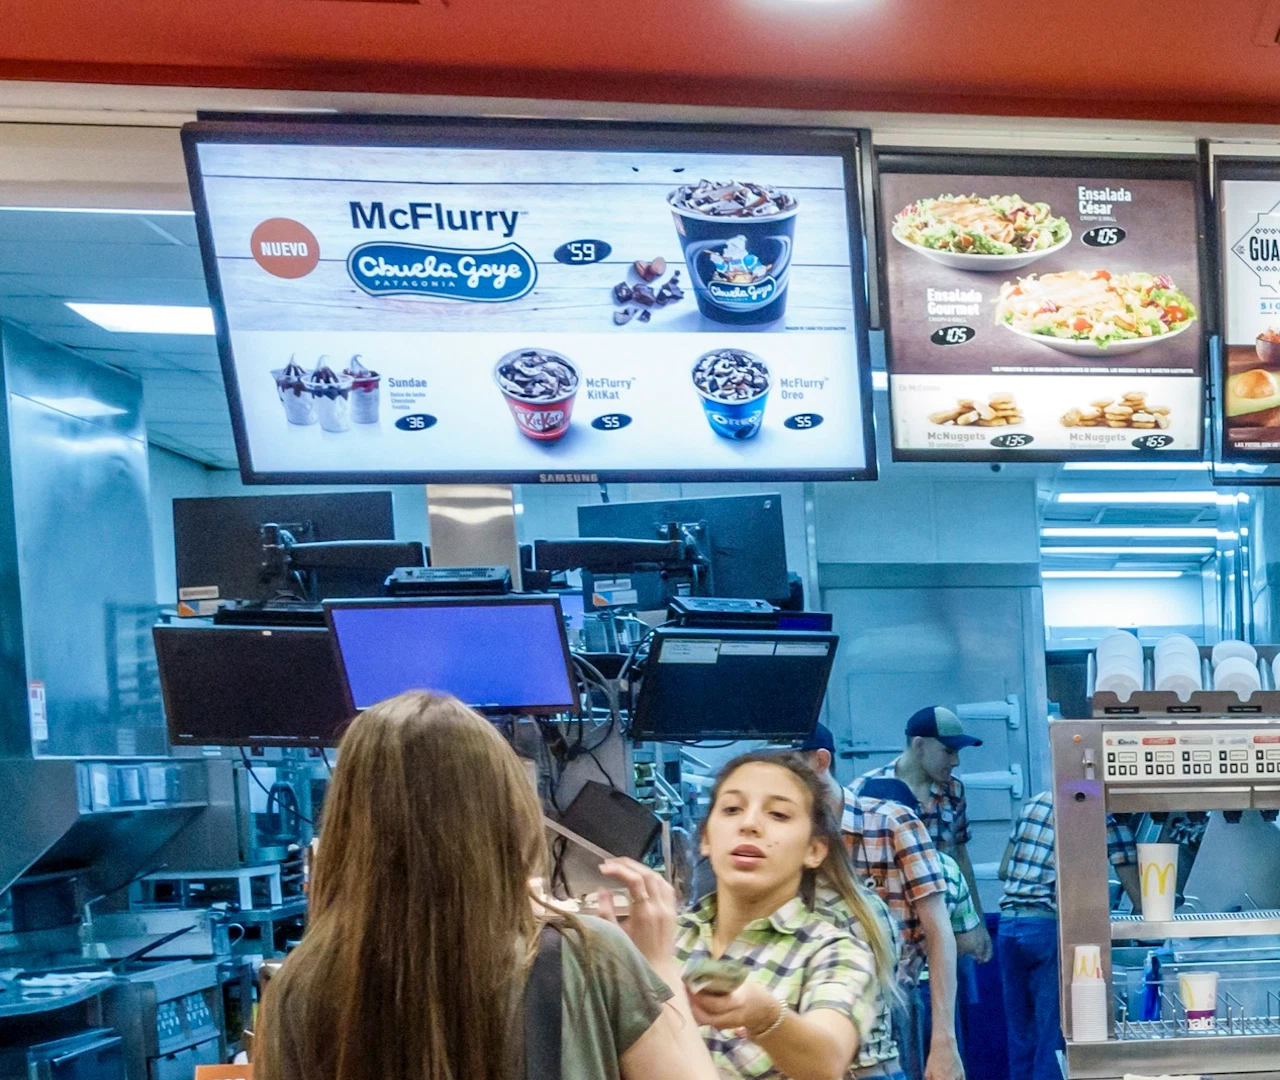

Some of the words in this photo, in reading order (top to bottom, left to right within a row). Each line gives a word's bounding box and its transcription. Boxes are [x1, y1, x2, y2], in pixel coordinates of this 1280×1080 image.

[1078, 186, 1132, 202] Ensalada
[1078, 200, 1113, 215] César
[350, 201, 519, 238] McFlurry
[260, 241, 308, 257] NUEVO
[358, 255, 458, 278] Abuela
[457, 255, 523, 289] Goye
[374, 279, 456, 288] PATAGONIA
[927, 288, 983, 302] Ensalada
[928, 301, 980, 316] Gourmet
[388, 377, 428, 389] Sundae
[586, 377, 632, 390] McFlurry
[780, 377, 824, 390] McFlurry
[588, 390, 620, 400] KitKat
[781, 390, 804, 400] Oreo
[928, 432, 986, 443] McNuggets
[1069, 432, 1126, 443] McNuggets
[539, 473, 598, 483] SAMSUNG
